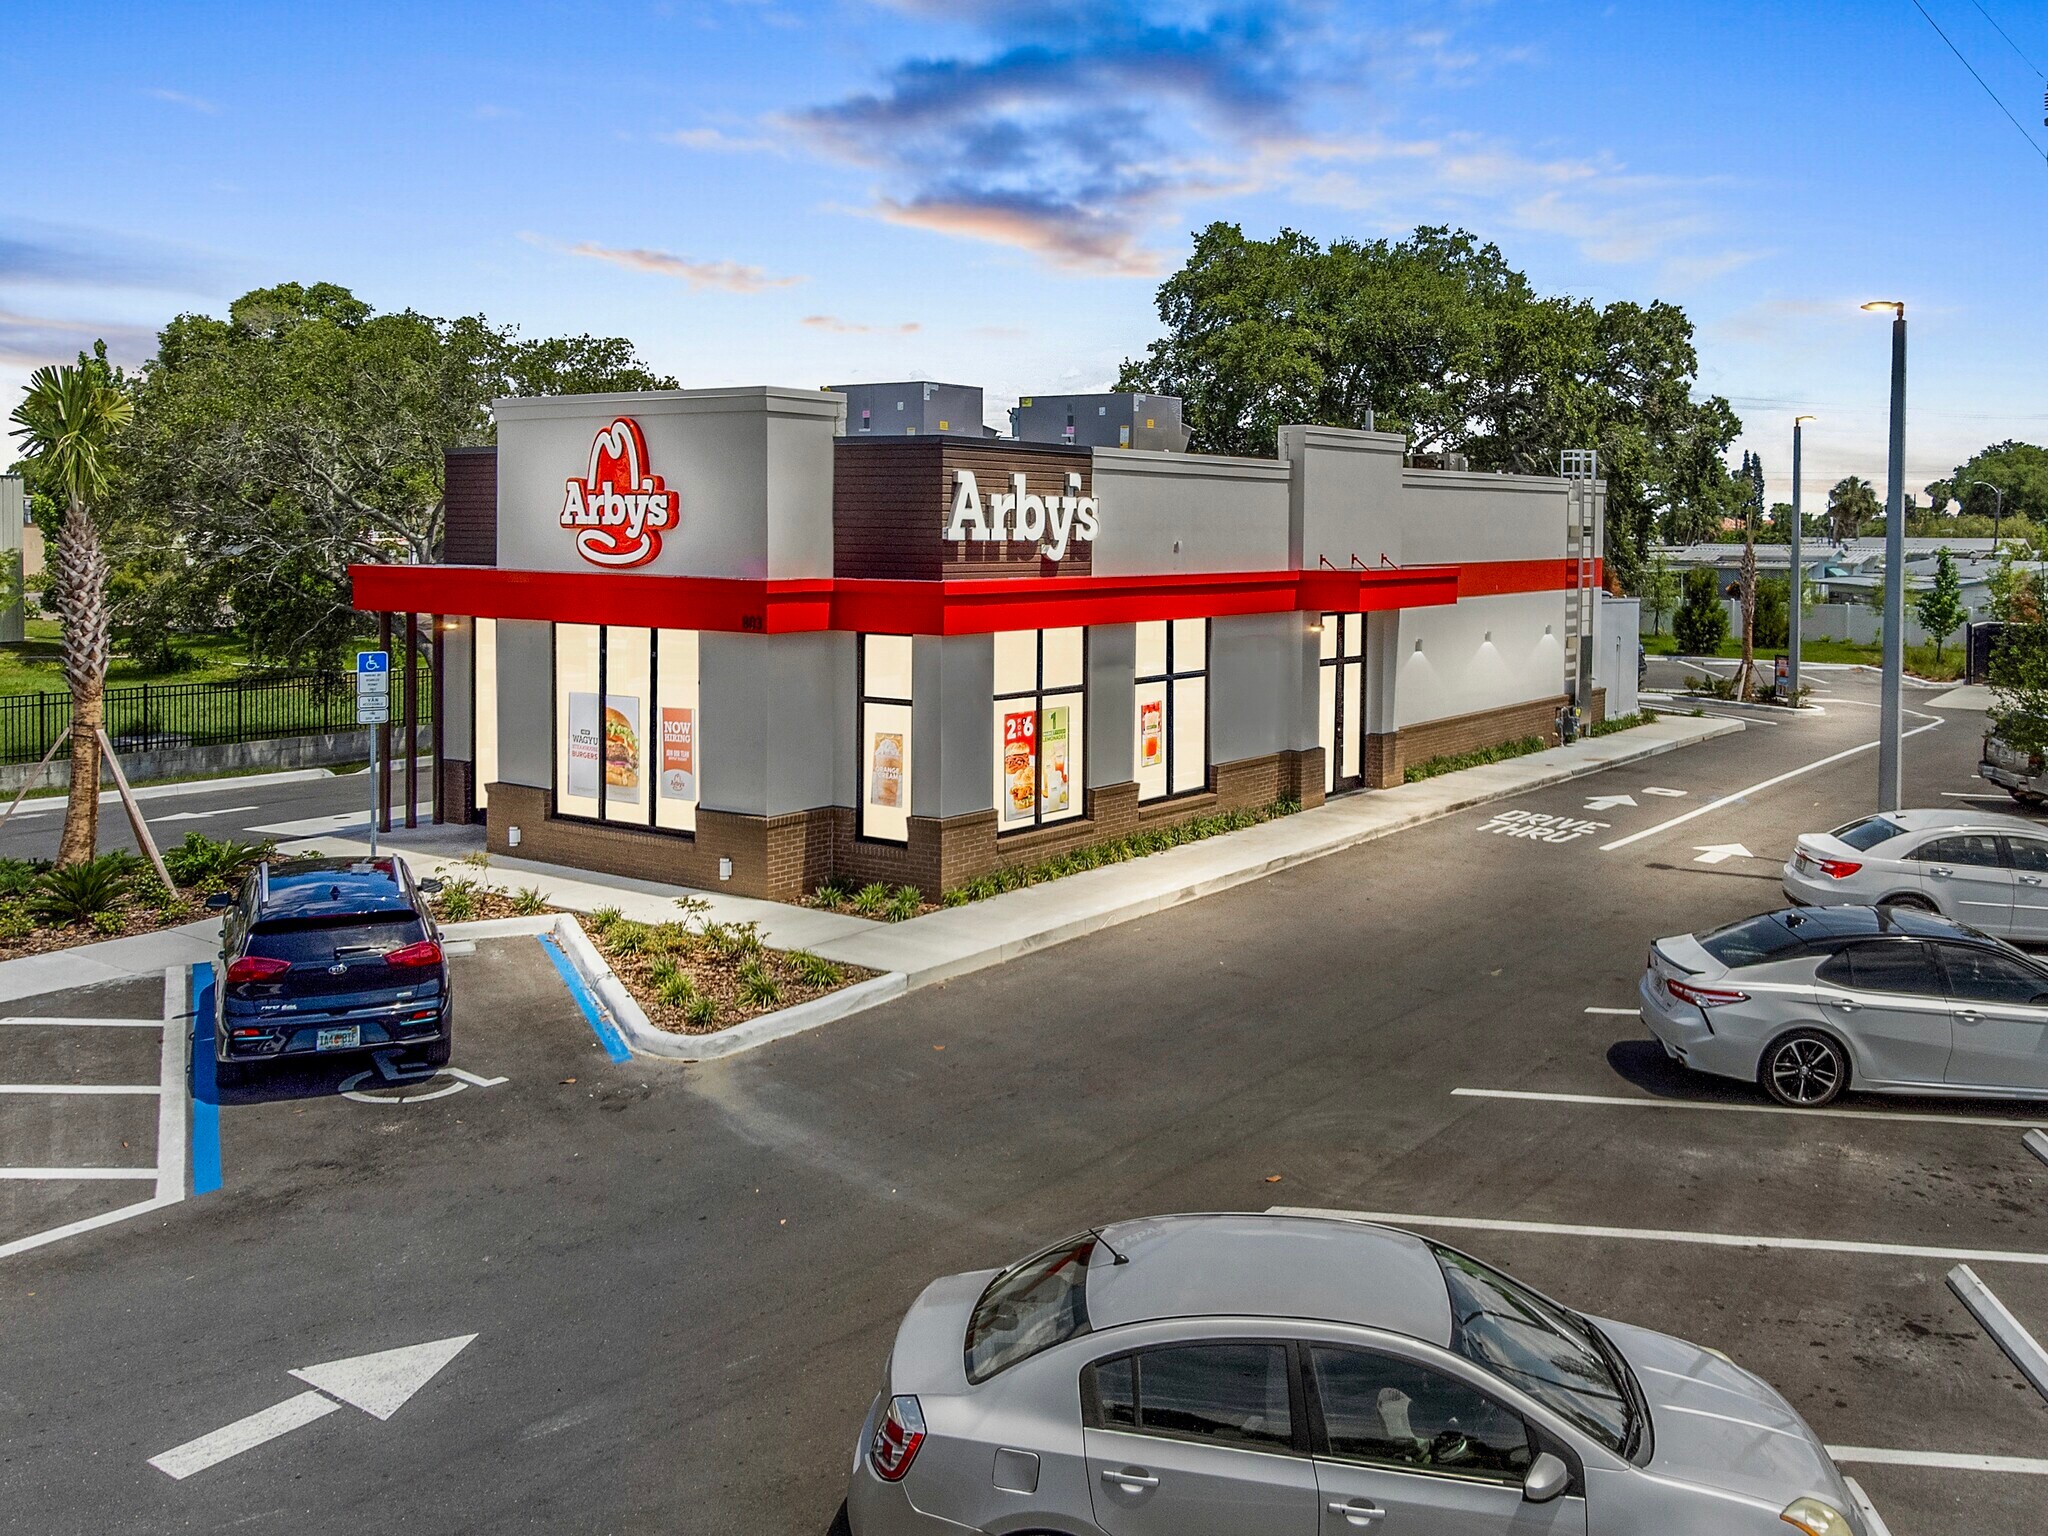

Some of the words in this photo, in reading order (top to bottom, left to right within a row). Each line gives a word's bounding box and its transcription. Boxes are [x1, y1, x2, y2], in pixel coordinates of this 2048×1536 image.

[561, 479, 668, 538] Arby's
[942, 470, 1099, 561] Arby's
[664, 721, 691, 734] NOW
[1006, 719, 1016, 740] 2
[572, 734, 598, 746] WAGYU
[664, 734, 690, 743] HIRING
[572, 751, 598, 760] BURGERS
[1476, 819, 1582, 843] THRU
[1493, 809, 1611, 834] DRIVE
